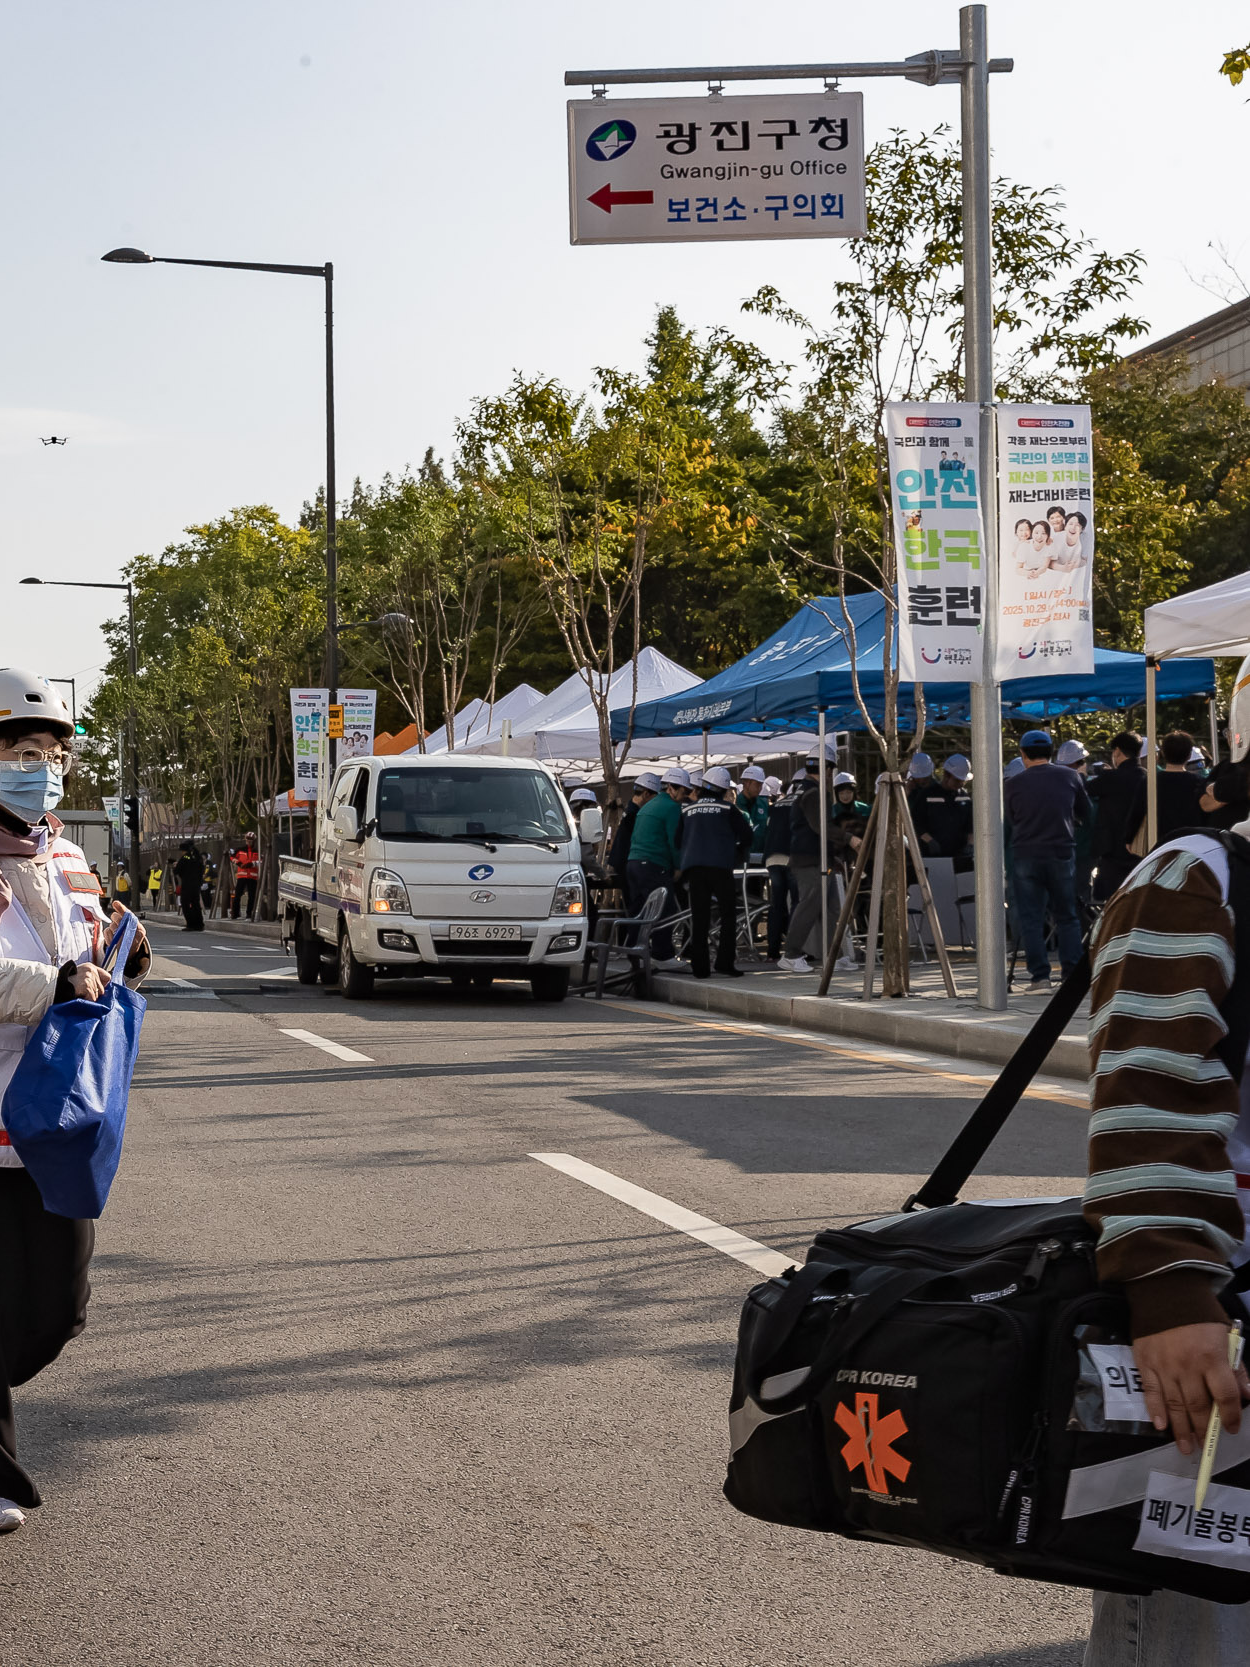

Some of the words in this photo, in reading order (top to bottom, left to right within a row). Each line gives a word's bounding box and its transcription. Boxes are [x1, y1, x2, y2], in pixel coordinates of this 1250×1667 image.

[655, 116, 850, 155] 광진구청
[660, 163, 784, 181] Gwangjin-gu
[790, 160, 847, 176] Office
[894, 436, 926, 447] 국민과
[929, 436, 950, 447] 함께
[1007, 436, 1027, 446] 각종
[1029, 436, 1087, 446] 재난으로부터
[1008, 452, 1047, 464] 국민의
[1051, 452, 1089, 464] 생명과
[1008, 470, 1048, 484] 재산을
[1052, 470, 1090, 482] 지키는
[896, 468, 978, 510] 안전
[1008, 488, 1091, 503] 재난대비훈련
[903, 529, 981, 570] 한국
[908, 585, 981, 626] 훈련
[456, 926, 479, 938] 96조
[484, 927, 515, 938] 6929
[836, 1369, 858, 1383] CPR
[860, 1371, 918, 1389] KOREA
[1020, 1496, 1032, 1514] CPR
[1015, 1514, 1030, 1544] KOREA
